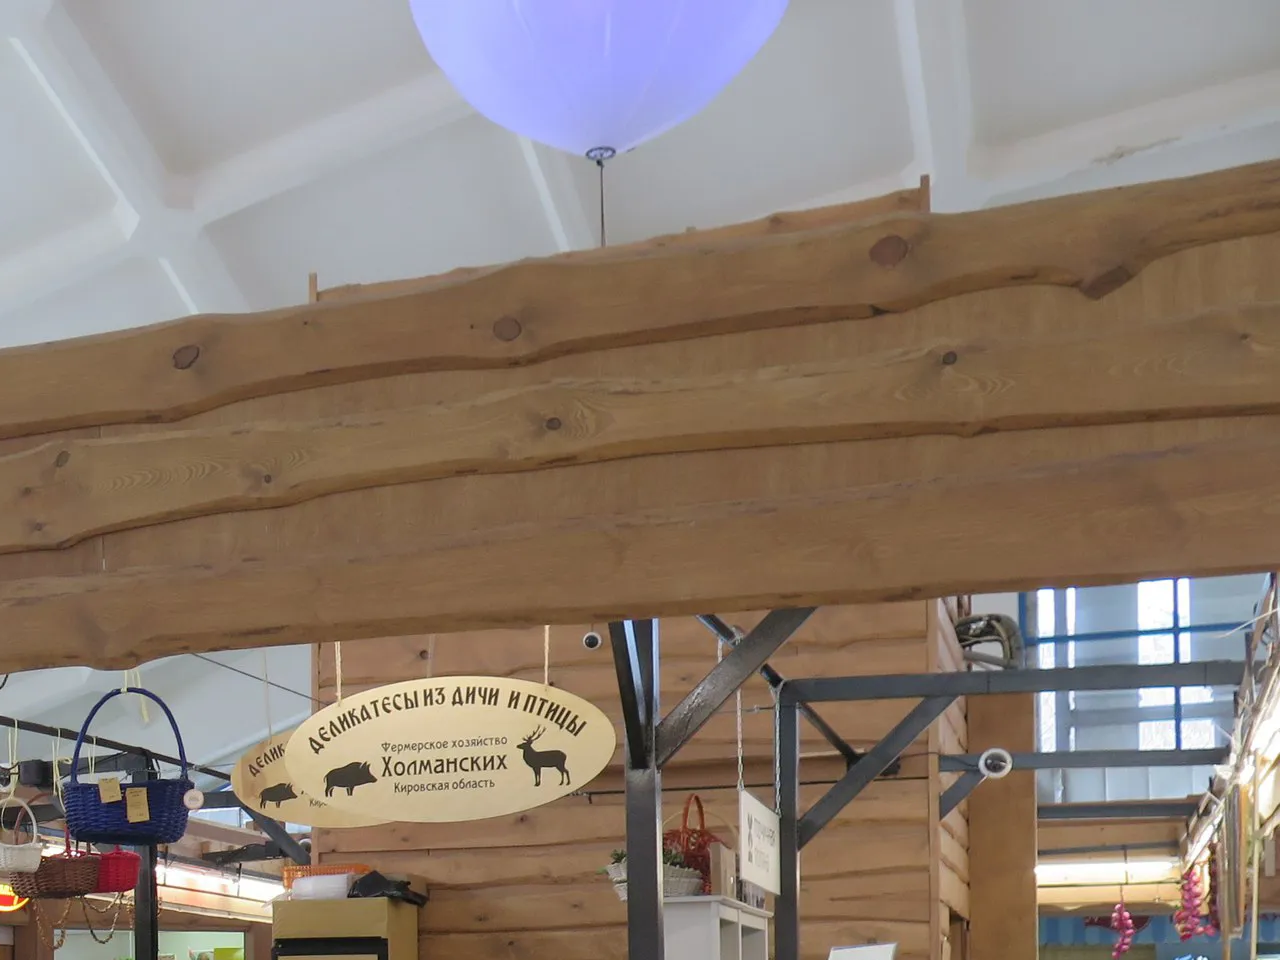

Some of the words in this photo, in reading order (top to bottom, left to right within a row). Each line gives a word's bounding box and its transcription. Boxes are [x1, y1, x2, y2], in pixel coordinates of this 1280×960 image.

[308, 689, 419, 755] ДЕЛИКАТЕСЫ
[423, 687, 446, 707] ИЗ
[451, 686, 500, 707] ДИЧИ
[507, 690, 521, 710] И
[523, 693, 588, 738] ПТИЦЫ
[381, 739, 449, 754] Фермерское
[451, 735, 508, 749] хозяйство
[381, 754, 508, 777] Холманских
[394, 780, 449, 796] Кировская
[451, 777, 495, 790] область
